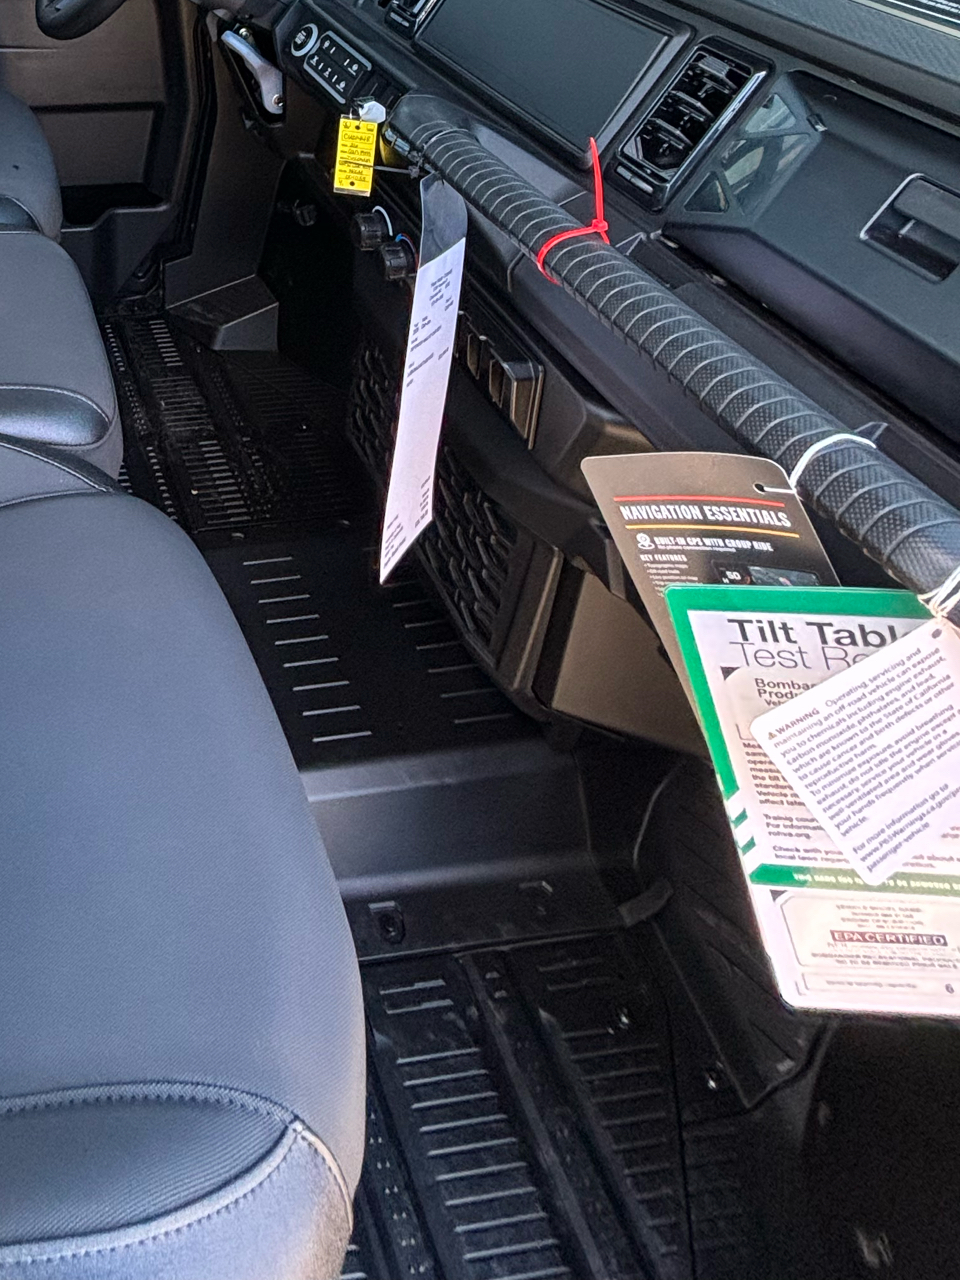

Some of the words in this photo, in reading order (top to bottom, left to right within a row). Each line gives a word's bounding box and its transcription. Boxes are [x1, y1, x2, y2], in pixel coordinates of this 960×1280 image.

[619, 505, 703, 521] NAVIGATION
[705, 507, 792, 527] ESSENTIALS
[653, 536, 686, 546] BUILT-IN
[687, 537, 703, 546] GPS
[702, 538, 724, 548] WITH
[725, 539, 752, 549] GROUP
[753, 541, 774, 551] RIDE
[727, 618, 797, 644] Tilt
[805, 622, 911, 648] Tabl
[729, 641, 812, 670] Test
[821, 646, 871, 671] Re
[755, 678, 817, 690] Bombar
[765, 698, 788, 707] Veh
[774, 718, 822, 749] maintaining
[823, 712, 832, 720] an
[834, 692, 866, 714] off-road
[867, 675, 895, 694] vehicle
[896, 666, 910, 677] can
[911, 647, 940, 668] expose
[776, 707, 819, 735] WARNING
[867, 658, 904, 683] servicing
[905, 648, 921, 660] and
[780, 745, 795, 757] you
[796, 738, 806, 747] to
[806, 716, 845, 742] chemicals
[846, 693, 883, 719] including
[884, 677, 912, 696] engine
[786, 744, 814, 764] carbon
[899, 685, 915, 697] and
[793, 756, 817, 773] which
[818, 749, 830, 758] are
[831, 731, 858, 750] known
[869, 717, 882, 727] the
[883, 704, 903, 719] State
[904, 697, 913, 705] of
[914, 674, 951, 701] California
[798, 772, 807, 781] to
[808, 759, 830, 775] cause
[832, 743, 858, 761] cancer
[858, 733, 873, 744] and
[874, 720, 894, 735] birth
[894, 702, 923, 723] defects
[934, 682, 955, 704] other
[804, 756, 854, 789] reproductive
[810, 787, 820, 796] To
[893, 728, 915, 744] avoid
[915, 703, 954, 730] breathing
[848, 774, 859, 784] do
[859, 765, 873, 777] not
[873, 755, 888, 768] idle
[889, 746, 902, 757] the
[902, 729, 930, 749] engine
[860, 768, 887, 788] service
[887, 756, 905, 770] your
[905, 739, 932, 758] vehicle
[932, 732, 941, 740] in
[882, 770, 900, 783] area
[900, 759, 915, 771] and
[916, 747, 934, 761] wear
[834, 814, 853, 829] your
[851, 798, 875, 816] hands
[874, 772, 914, 800] frequently
[913, 757, 936, 774] when
[852, 842, 866, 853] For
[865, 827, 886, 844] more
[884, 798, 930, 829] information
[928, 789, 940, 800] go
[939, 783, 949, 792] to
[783, 822, 826, 832] informati
[832, 931, 863, 942] EPA
[864, 932, 945, 945] CERTIFIED
